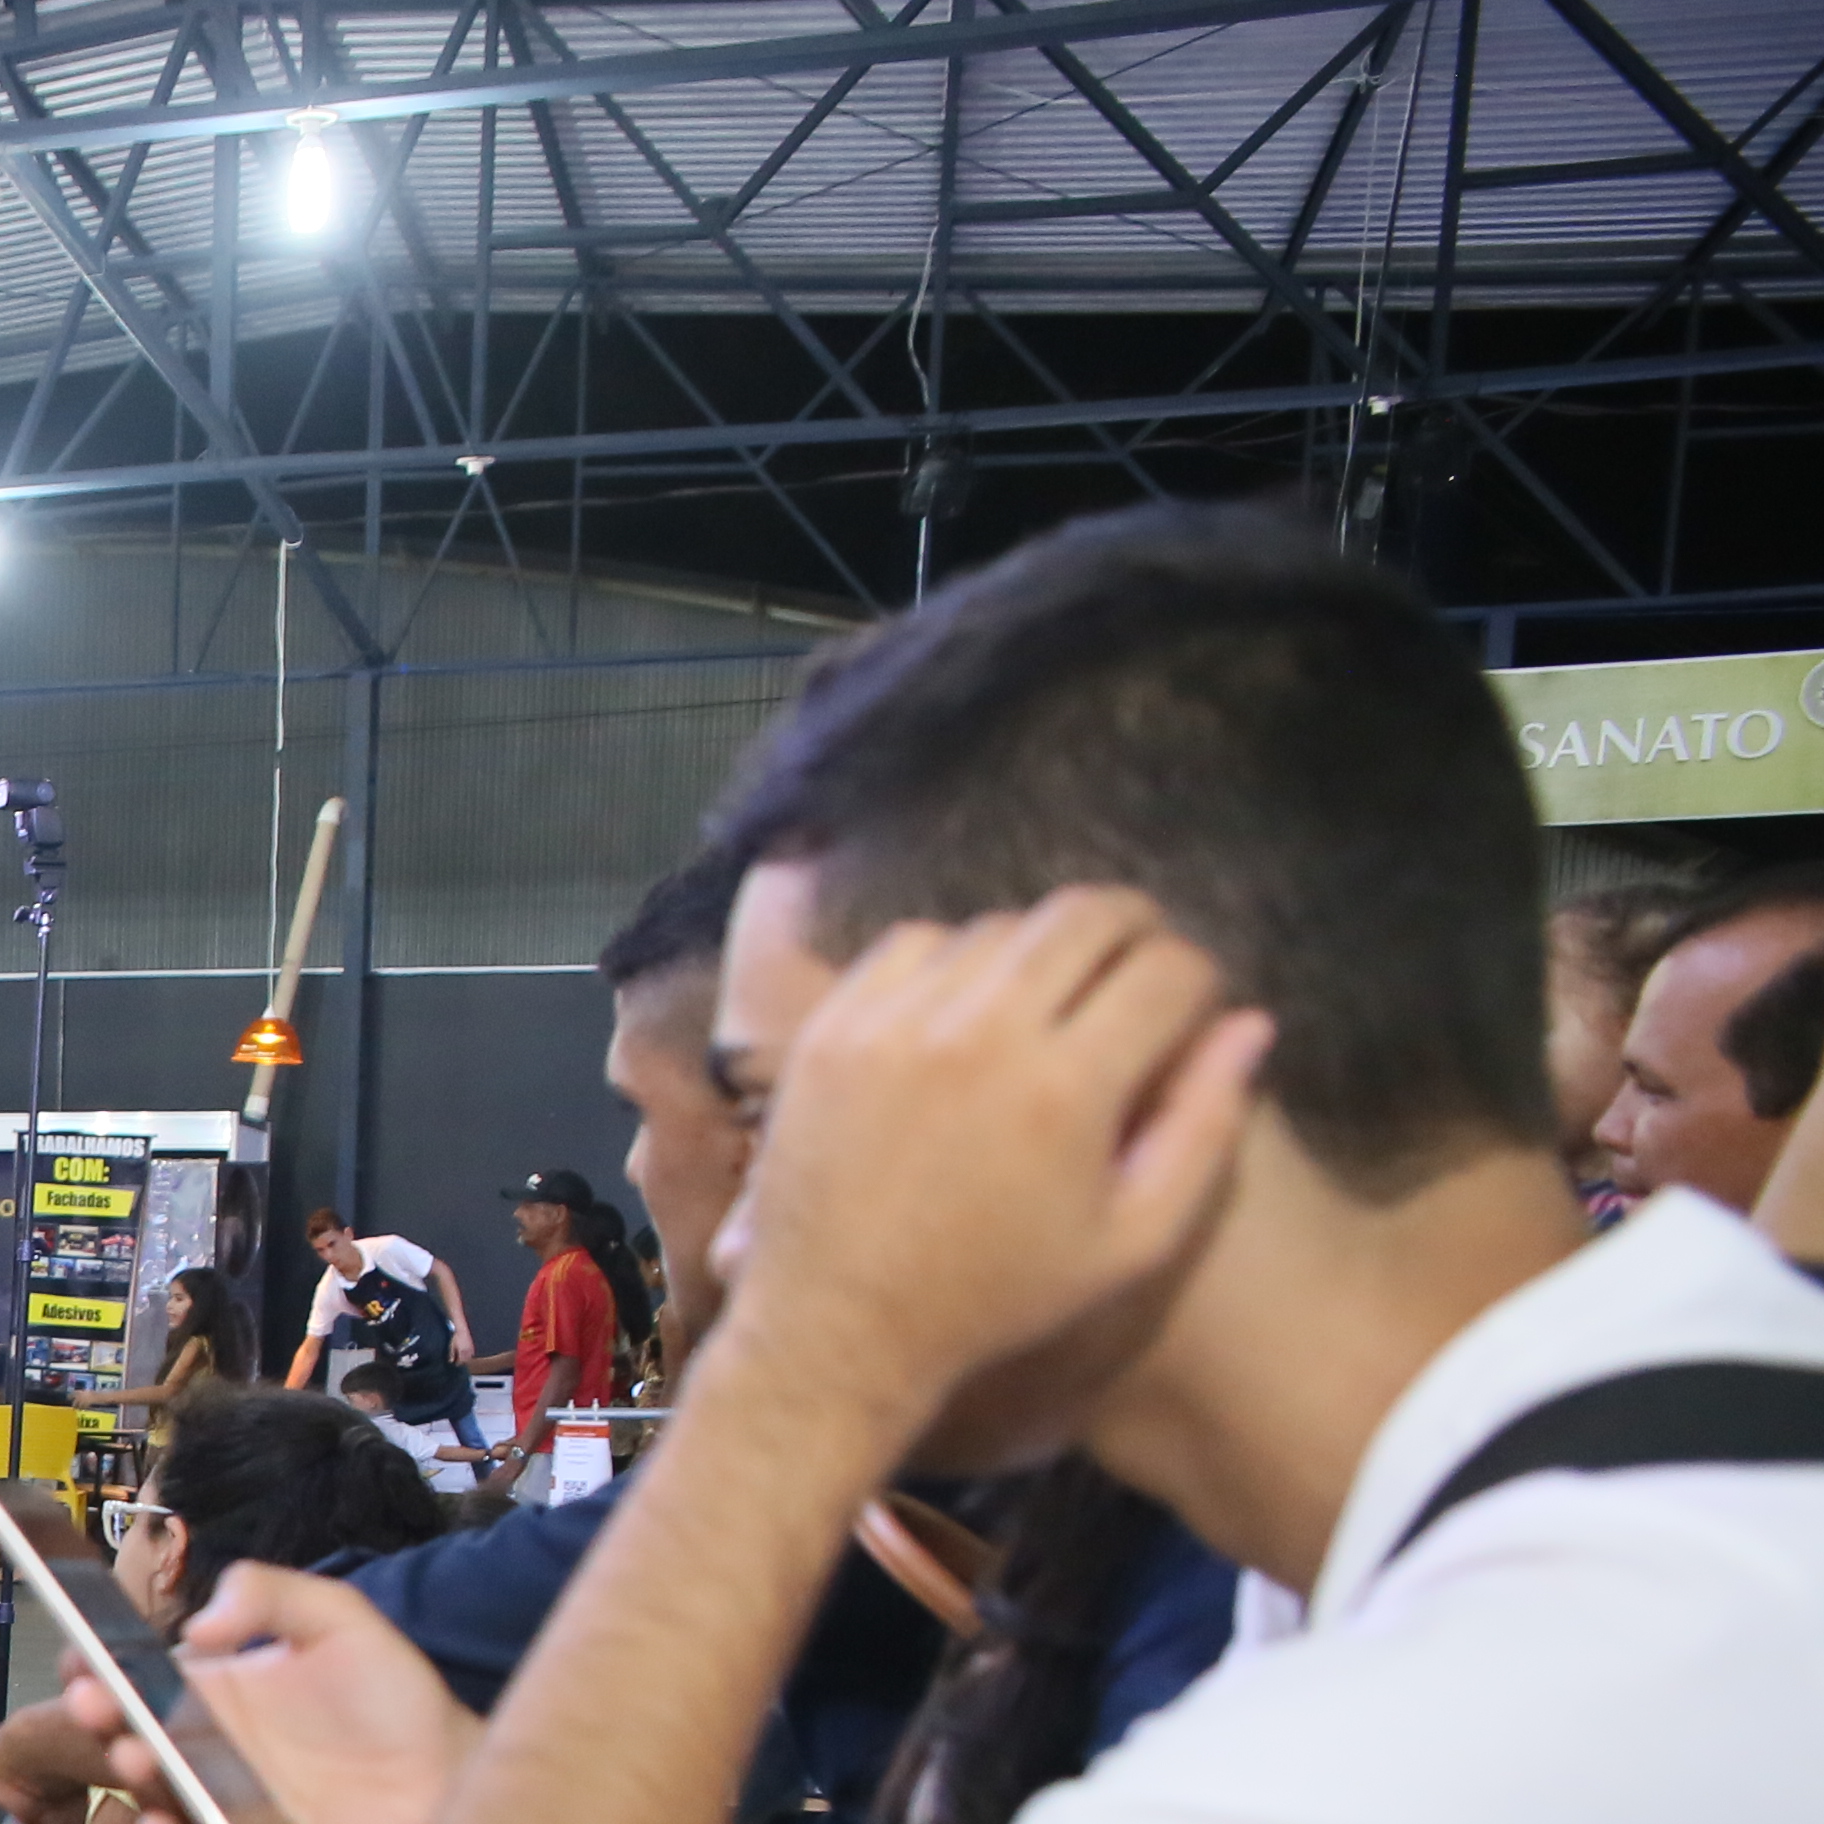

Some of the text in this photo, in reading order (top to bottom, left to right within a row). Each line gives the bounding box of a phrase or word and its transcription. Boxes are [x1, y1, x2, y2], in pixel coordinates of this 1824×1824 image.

[53, 1157, 111, 1182] COM:
[46, 1190, 112, 1209] Fachadas
[42, 1302, 102, 1323] Adesivos
